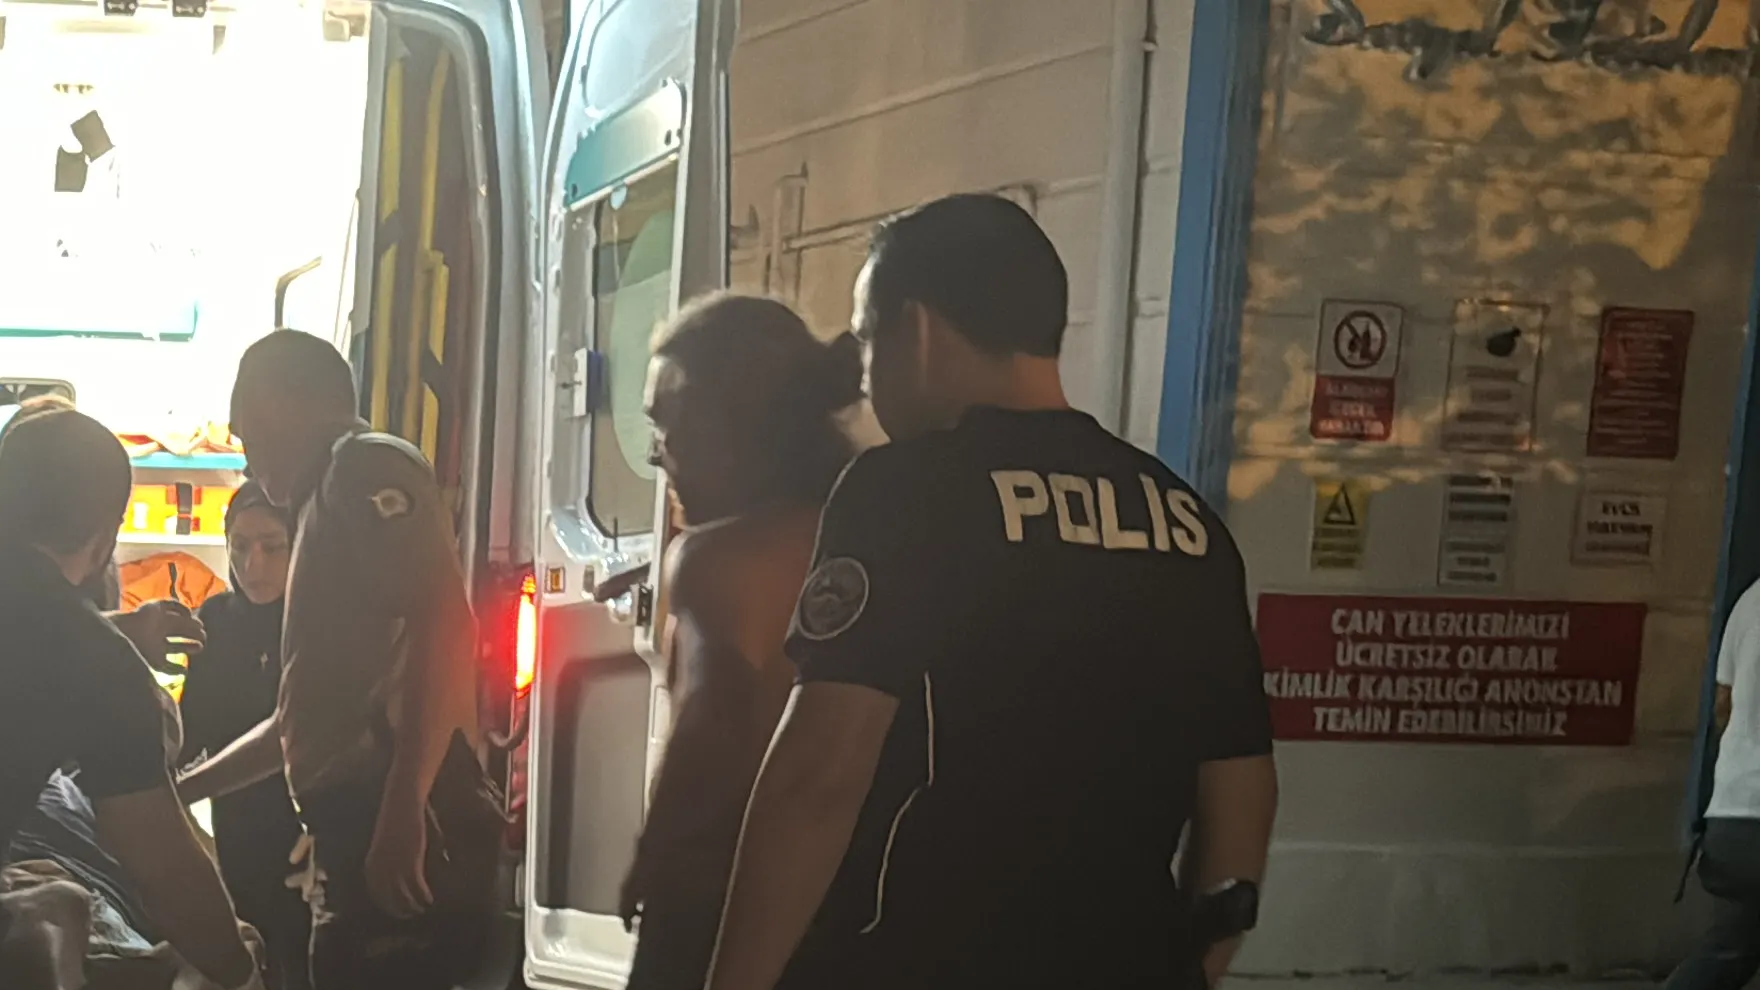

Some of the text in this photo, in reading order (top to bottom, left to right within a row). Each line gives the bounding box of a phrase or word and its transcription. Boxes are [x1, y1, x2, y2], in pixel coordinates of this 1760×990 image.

[1331, 608, 1384, 635] CAN
[1457, 644, 1558, 672] OLARAK
[1263, 667, 1353, 699] KİMLİK
[1484, 677, 1623, 707] ANONSTAN
[1313, 705, 1391, 734] TEMİN
